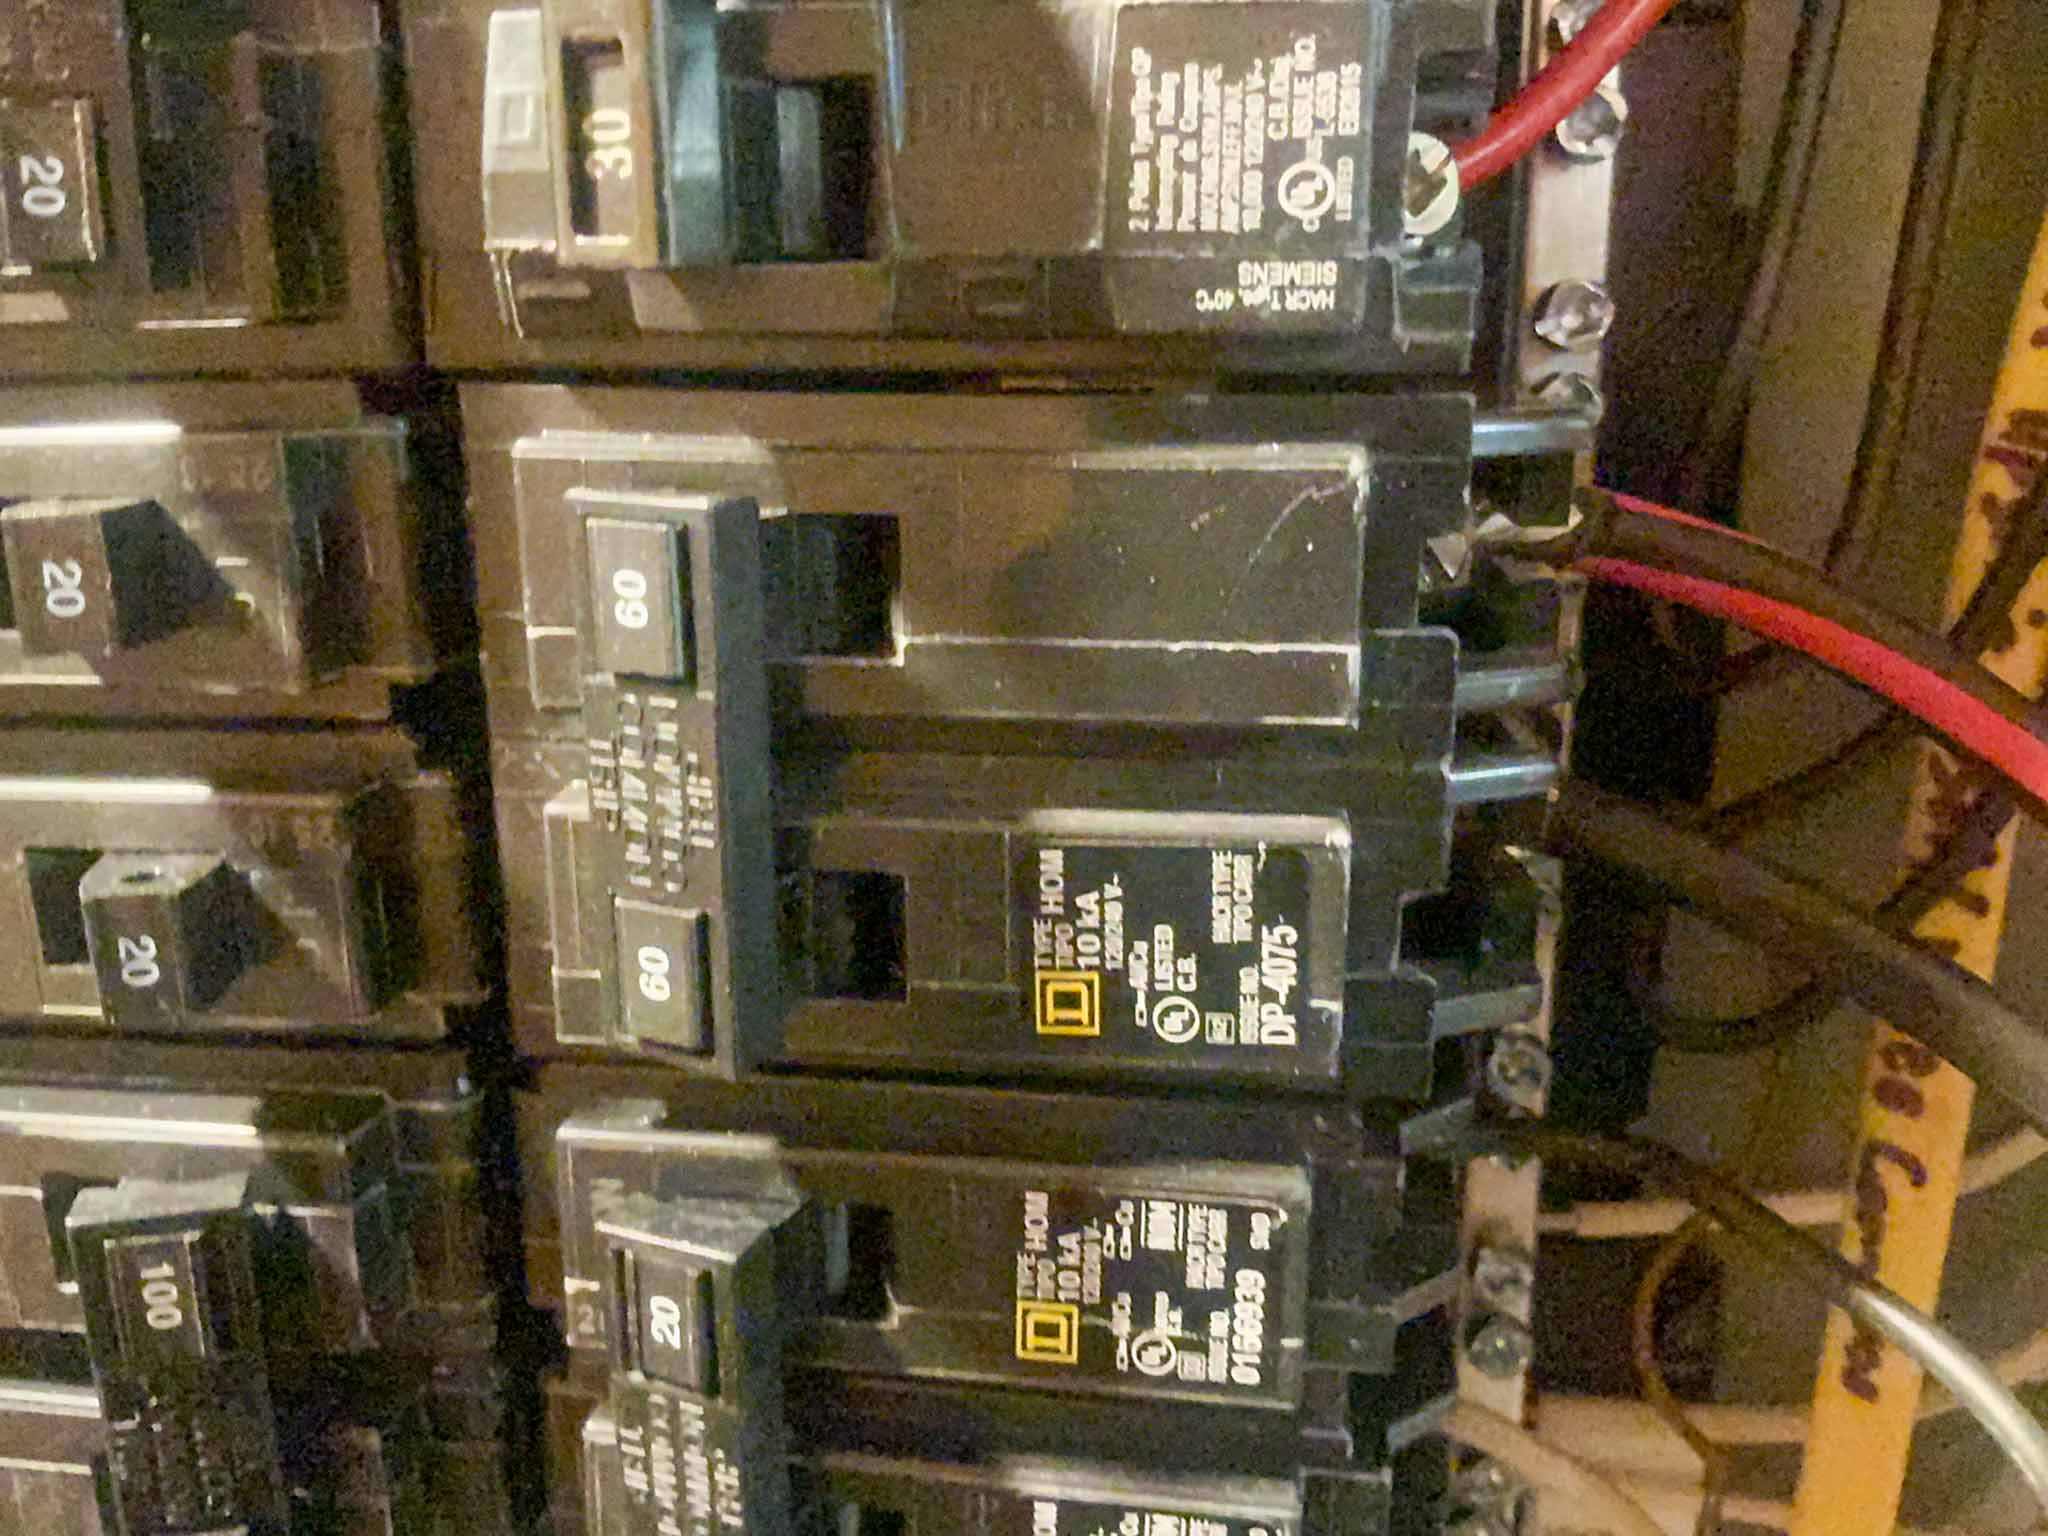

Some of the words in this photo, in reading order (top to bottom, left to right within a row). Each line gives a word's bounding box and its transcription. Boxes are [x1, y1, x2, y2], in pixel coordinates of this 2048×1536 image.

[586, 108, 632, 180] 30
[19, 155, 66, 216] 20
[1129, 218, 1149, 232] 2
[1238, 261, 1337, 286] SIEMENS
[1285, 289, 1335, 310] HACR
[42, 559, 84, 617] 20
[614, 568, 647, 629] 60
[1040, 849, 1064, 914] HOM
[1076, 891, 1100, 928] kA
[118, 935, 160, 987] 20
[1034, 918, 1052, 967] TYPE
[1078, 934, 1100, 969] 10
[1155, 924, 1173, 991] LISTED
[638, 945, 670, 1001] 60
[1025, 1191, 1048, 1250] HOM
[140, 1262, 181, 1329] 100
[1058, 1270, 1080, 1302] 10
[651, 1296, 680, 1349] 20
